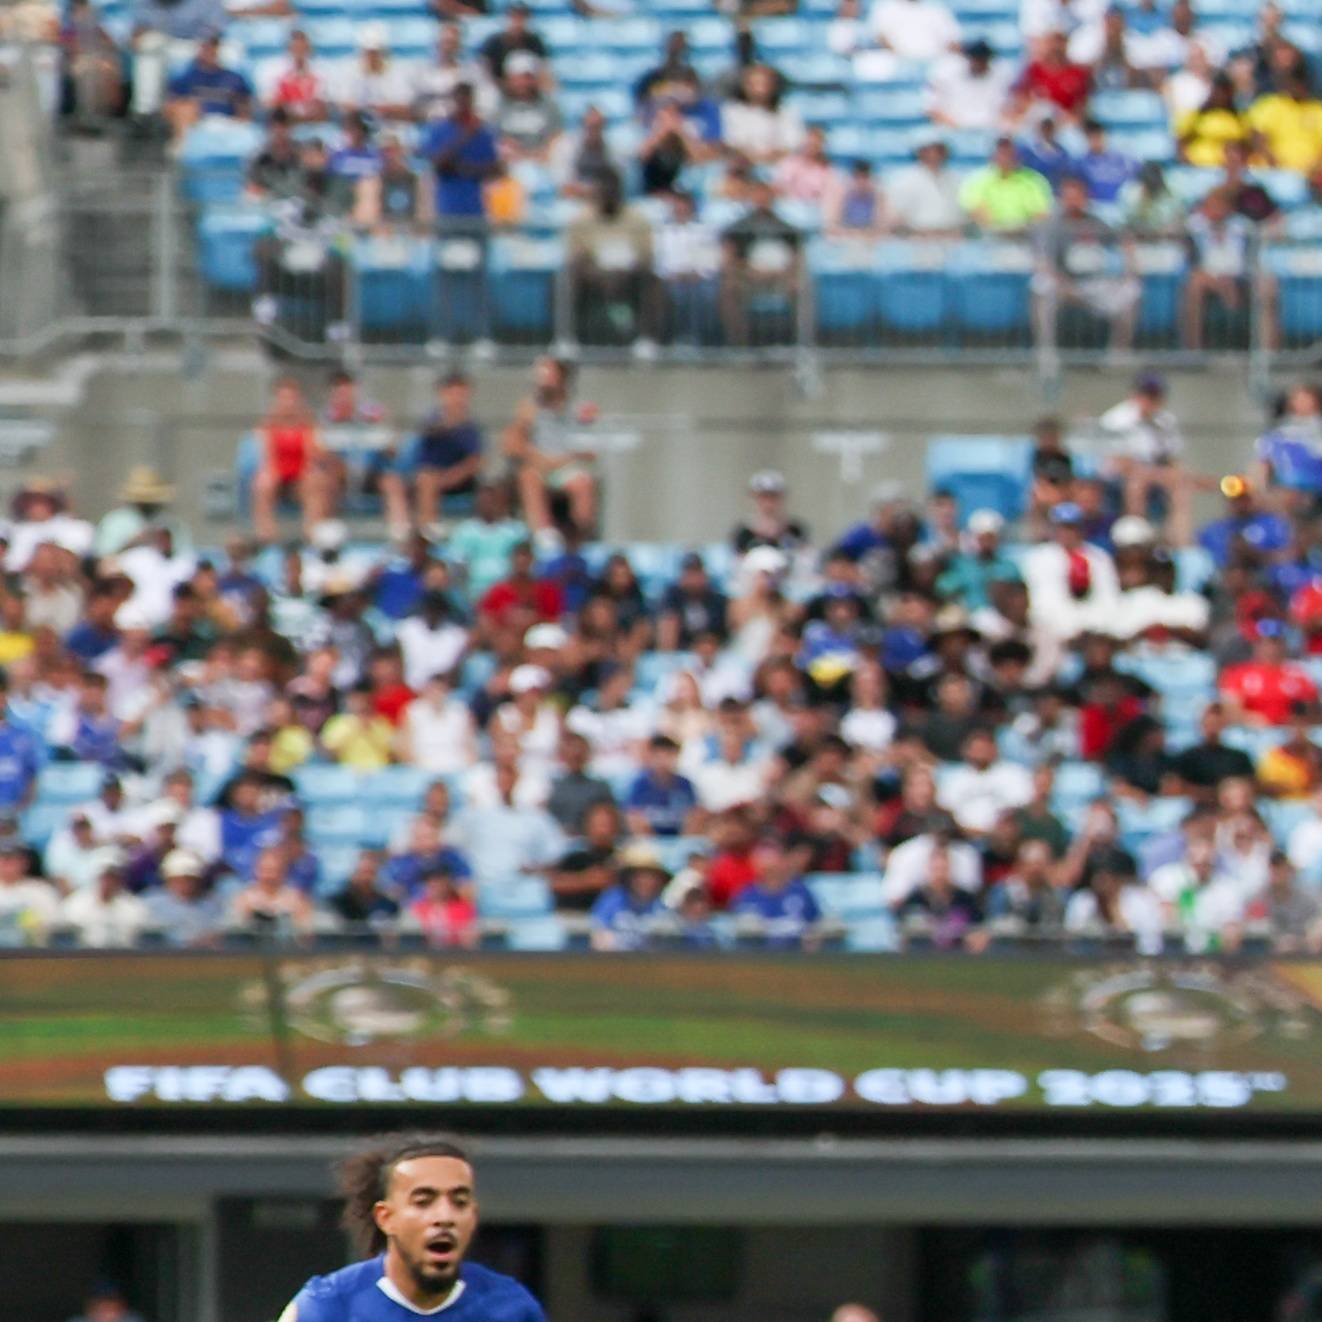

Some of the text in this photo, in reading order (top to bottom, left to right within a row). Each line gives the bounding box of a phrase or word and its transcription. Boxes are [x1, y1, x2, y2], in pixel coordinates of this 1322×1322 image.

[104, 1066, 289, 1102] FIFA
[302, 1066, 525, 1103] CLUB
[532, 1067, 845, 1104] WORLD
[853, 1068, 1028, 1105] CUP
